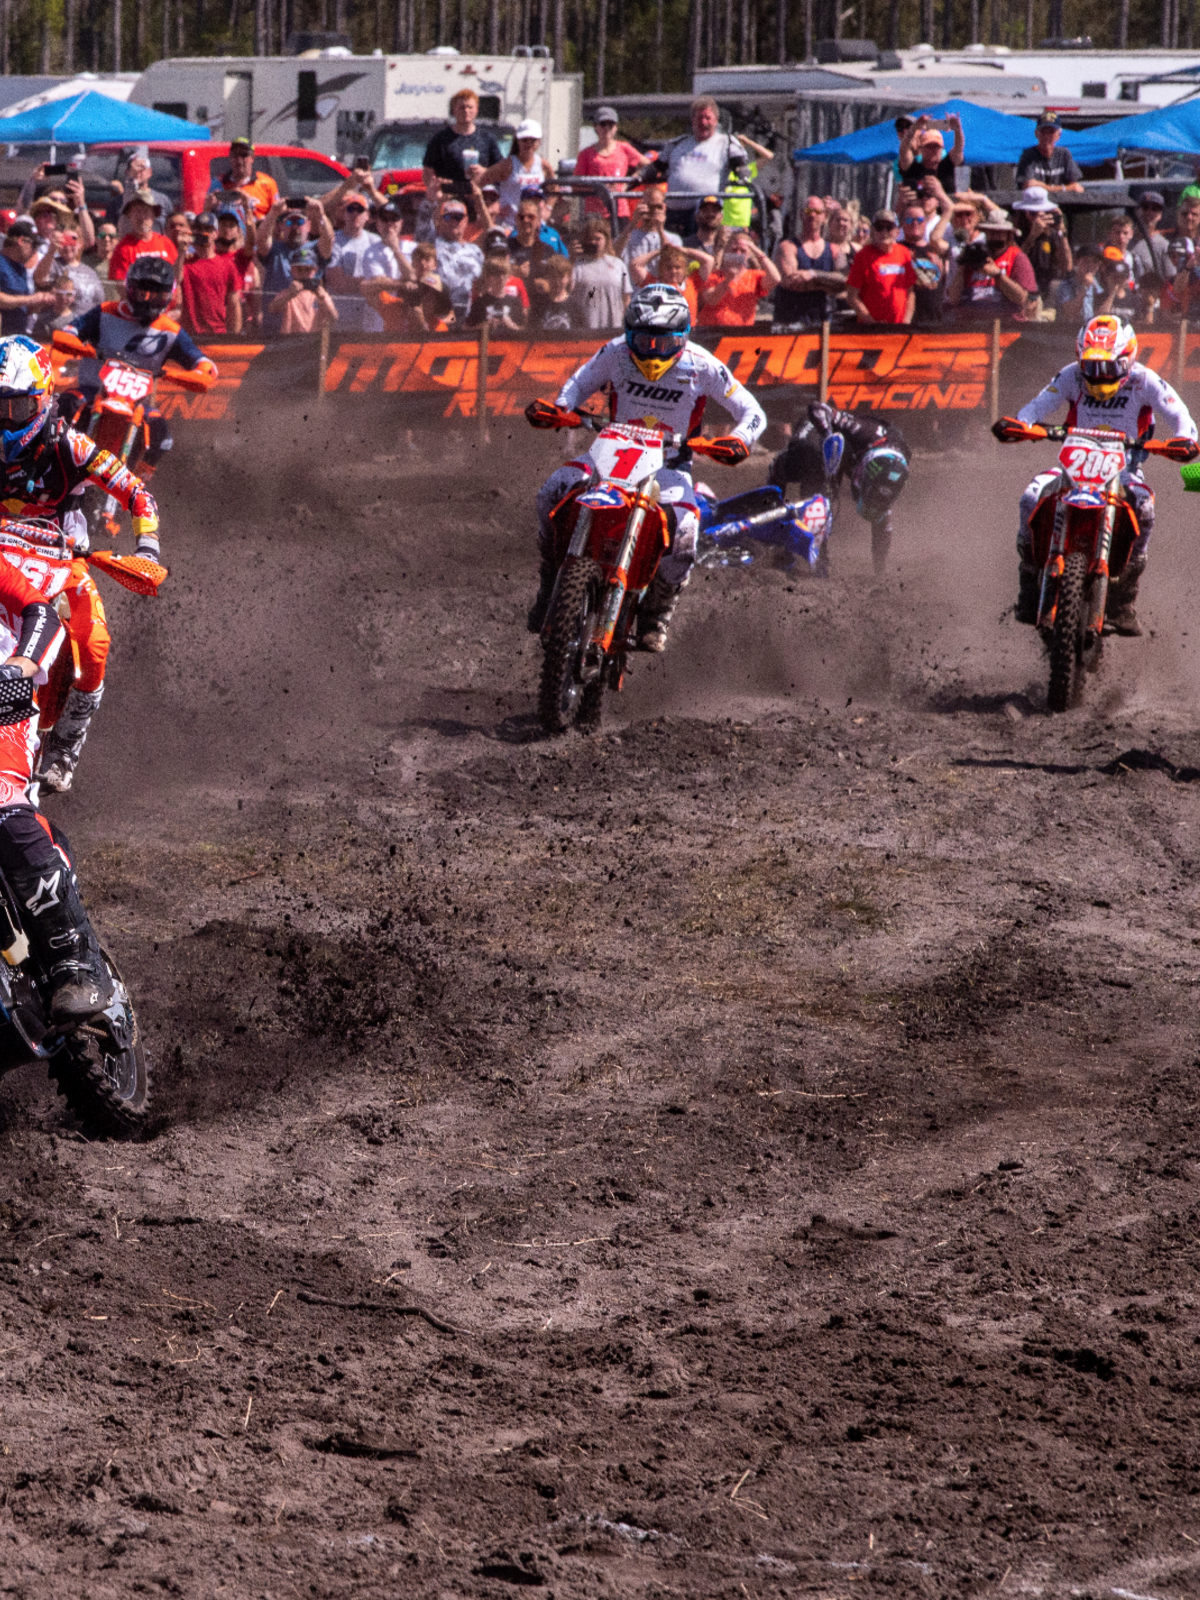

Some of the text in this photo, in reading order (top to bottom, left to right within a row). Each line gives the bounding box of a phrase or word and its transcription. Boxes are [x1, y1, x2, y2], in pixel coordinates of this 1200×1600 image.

[321, 341, 615, 392] MOOS
[712, 333, 1018, 386] MOOSE
[104, 367, 150, 400] 455
[627, 381, 684, 403] THOR
[824, 384, 986, 410] RACING
[746, 414, 762, 434] THOR
[1071, 426, 1122, 438] RENTHAL
[609, 447, 644, 480] 1
[1068, 448, 1121, 480] 206
